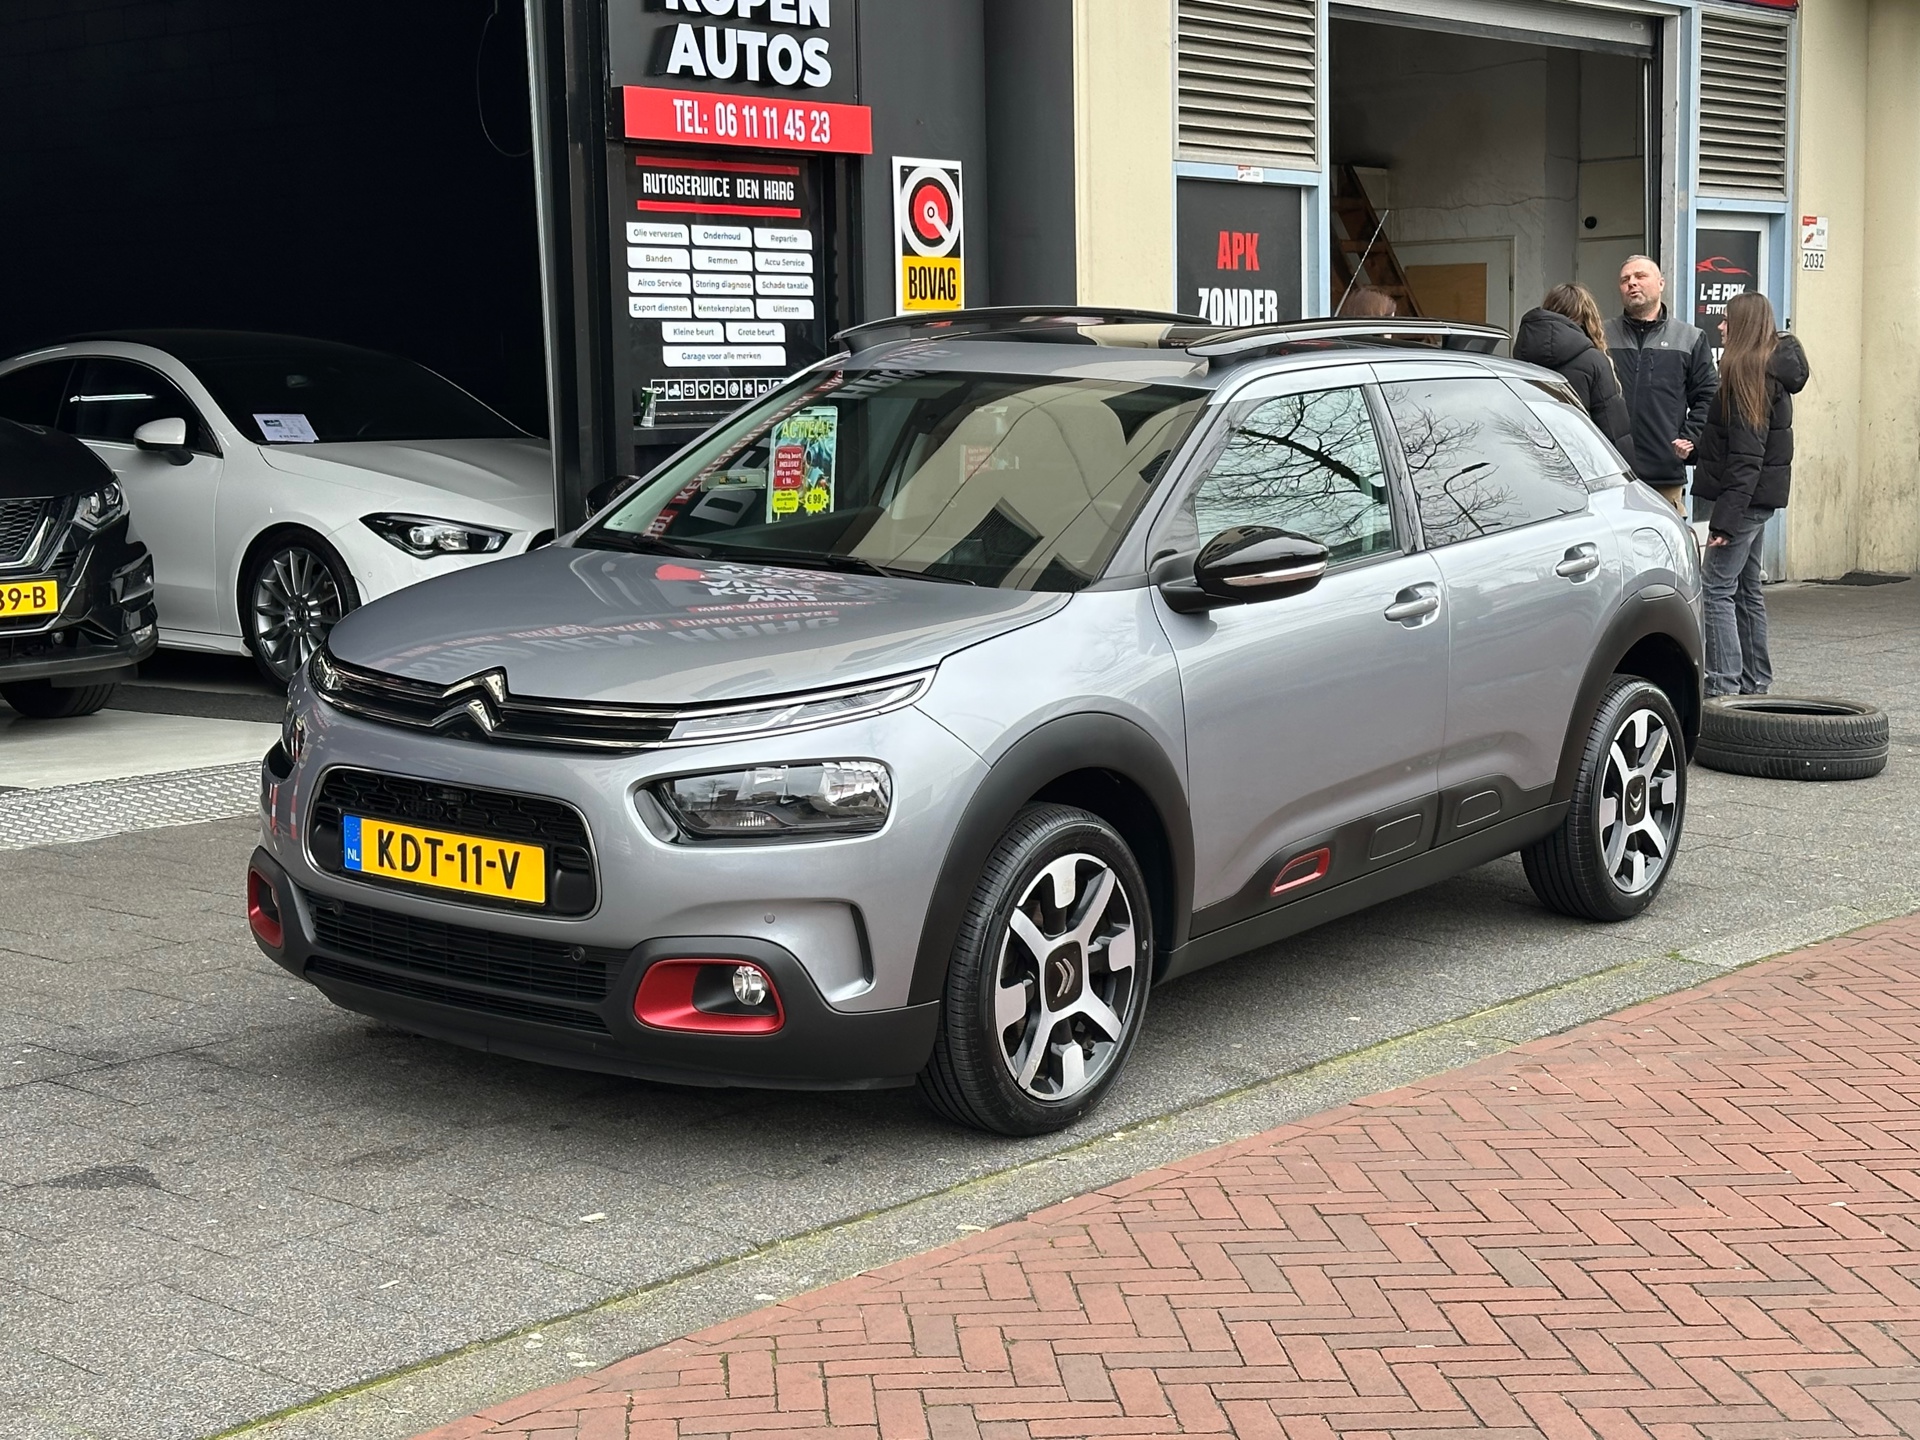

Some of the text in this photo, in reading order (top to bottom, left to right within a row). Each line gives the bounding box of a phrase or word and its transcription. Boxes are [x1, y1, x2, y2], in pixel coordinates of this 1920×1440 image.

[666, 23, 832, 88] AUTOS
[673, 99, 831, 145] TEL: 06 11 11 45 23
[643, 172, 794, 201] AUTOSERVICE DEN HAAG
[633, 229, 683, 239] Olie verversen
[703, 232, 741, 240] Onderhoud
[1217, 229, 1260, 271] APK
[645, 254, 672, 263] Banden
[708, 256, 738, 264] Remmen
[764, 258, 805, 267] Accu Service
[1803, 252, 1824, 269] 2032
[637, 279, 682, 288] Airco Service
[696, 280, 751, 291] Storing diagnose
[762, 281, 808, 290] Schade taxatie
[908, 266, 957, 301] BOVAG
[634, 303, 688, 312] Export diensten
[698, 304, 750, 314] Kentekenplaten
[773, 305, 799, 313] Uitlezen
[1198, 287, 1279, 327] ZONDER
[673, 328, 715, 336] Kleine beurt
[737, 328, 775, 336] Grote beurt
[681, 352, 761, 362] Garage voor alle merken
[347, 847, 360, 862] NL
[377, 828, 521, 890] KDT-11-V
